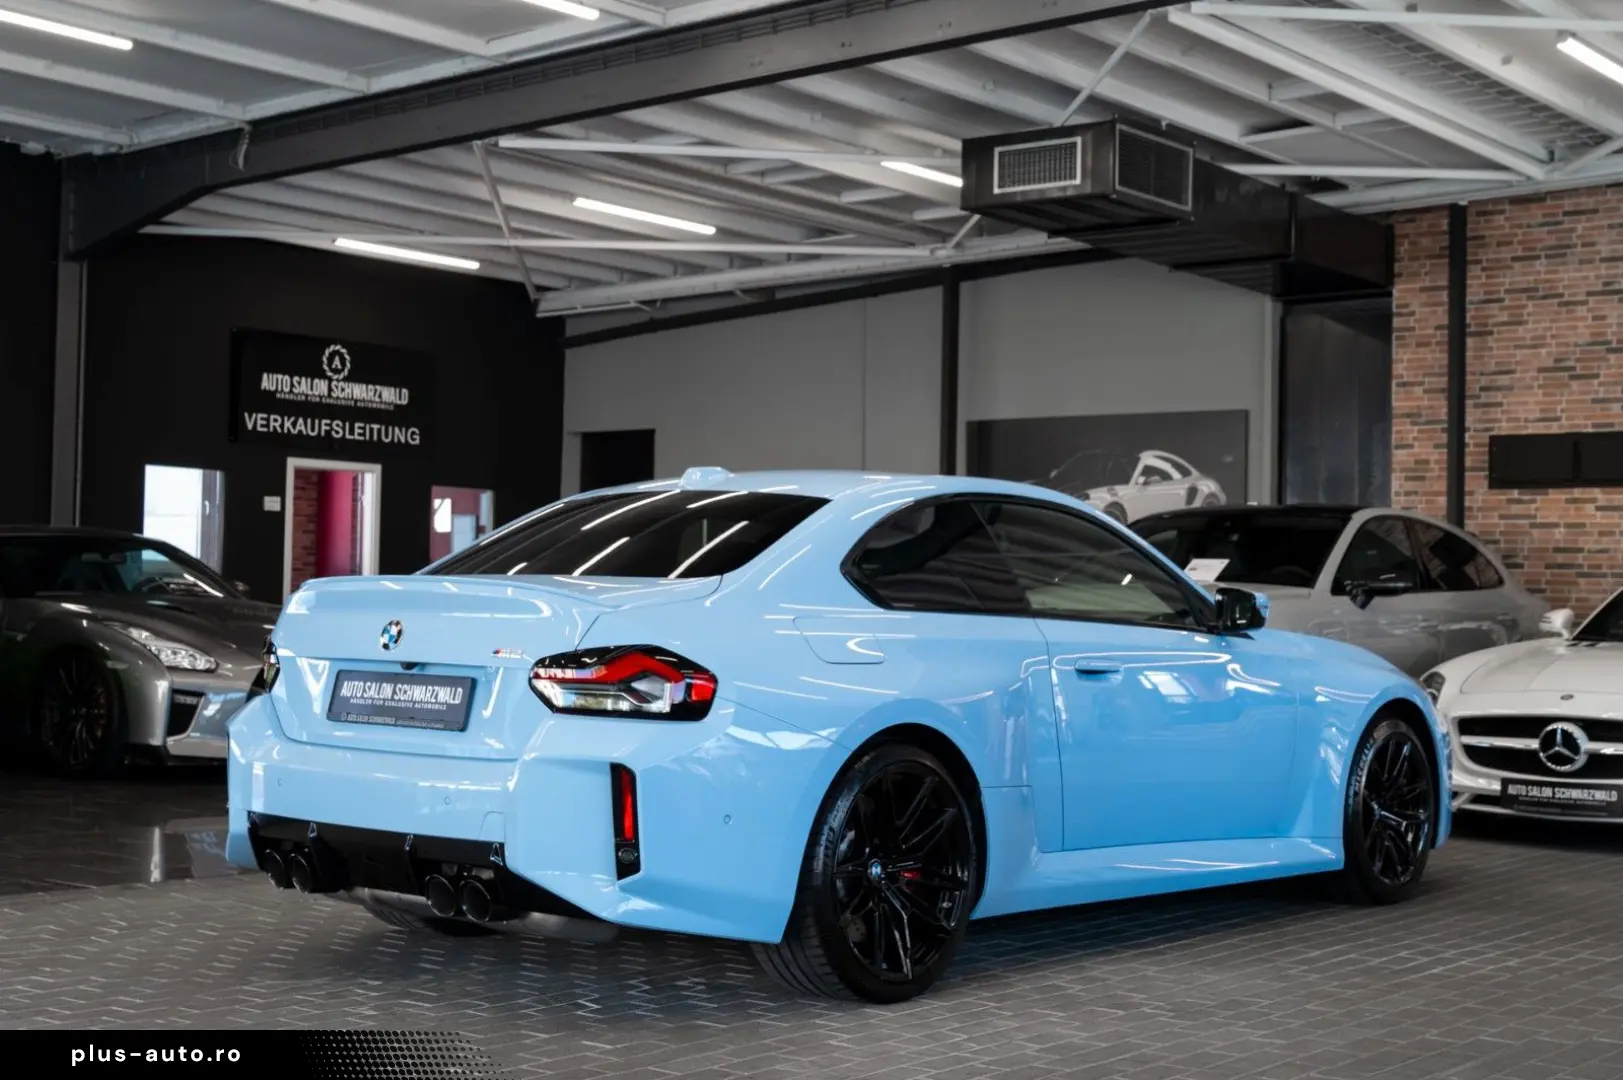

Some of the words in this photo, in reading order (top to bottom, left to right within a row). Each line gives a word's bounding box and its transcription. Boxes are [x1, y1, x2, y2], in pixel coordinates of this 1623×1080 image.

[331, 355, 342, 369] A
[261, 372, 291, 393] AUTO
[292, 376, 329, 397] SALON
[330, 380, 409, 405] SCHWARZWALD
[244, 411, 421, 445] VERKAUFSLEITUNG
[340, 680, 363, 698] AUTO
[363, 682, 393, 700] SALON
[394, 684, 463, 704] SCHWARZWALD
[1507, 783, 1527, 795] AUTO
[1527, 785, 1553, 797] SALON
[1554, 787, 1618, 802] SCHWARZWALD
